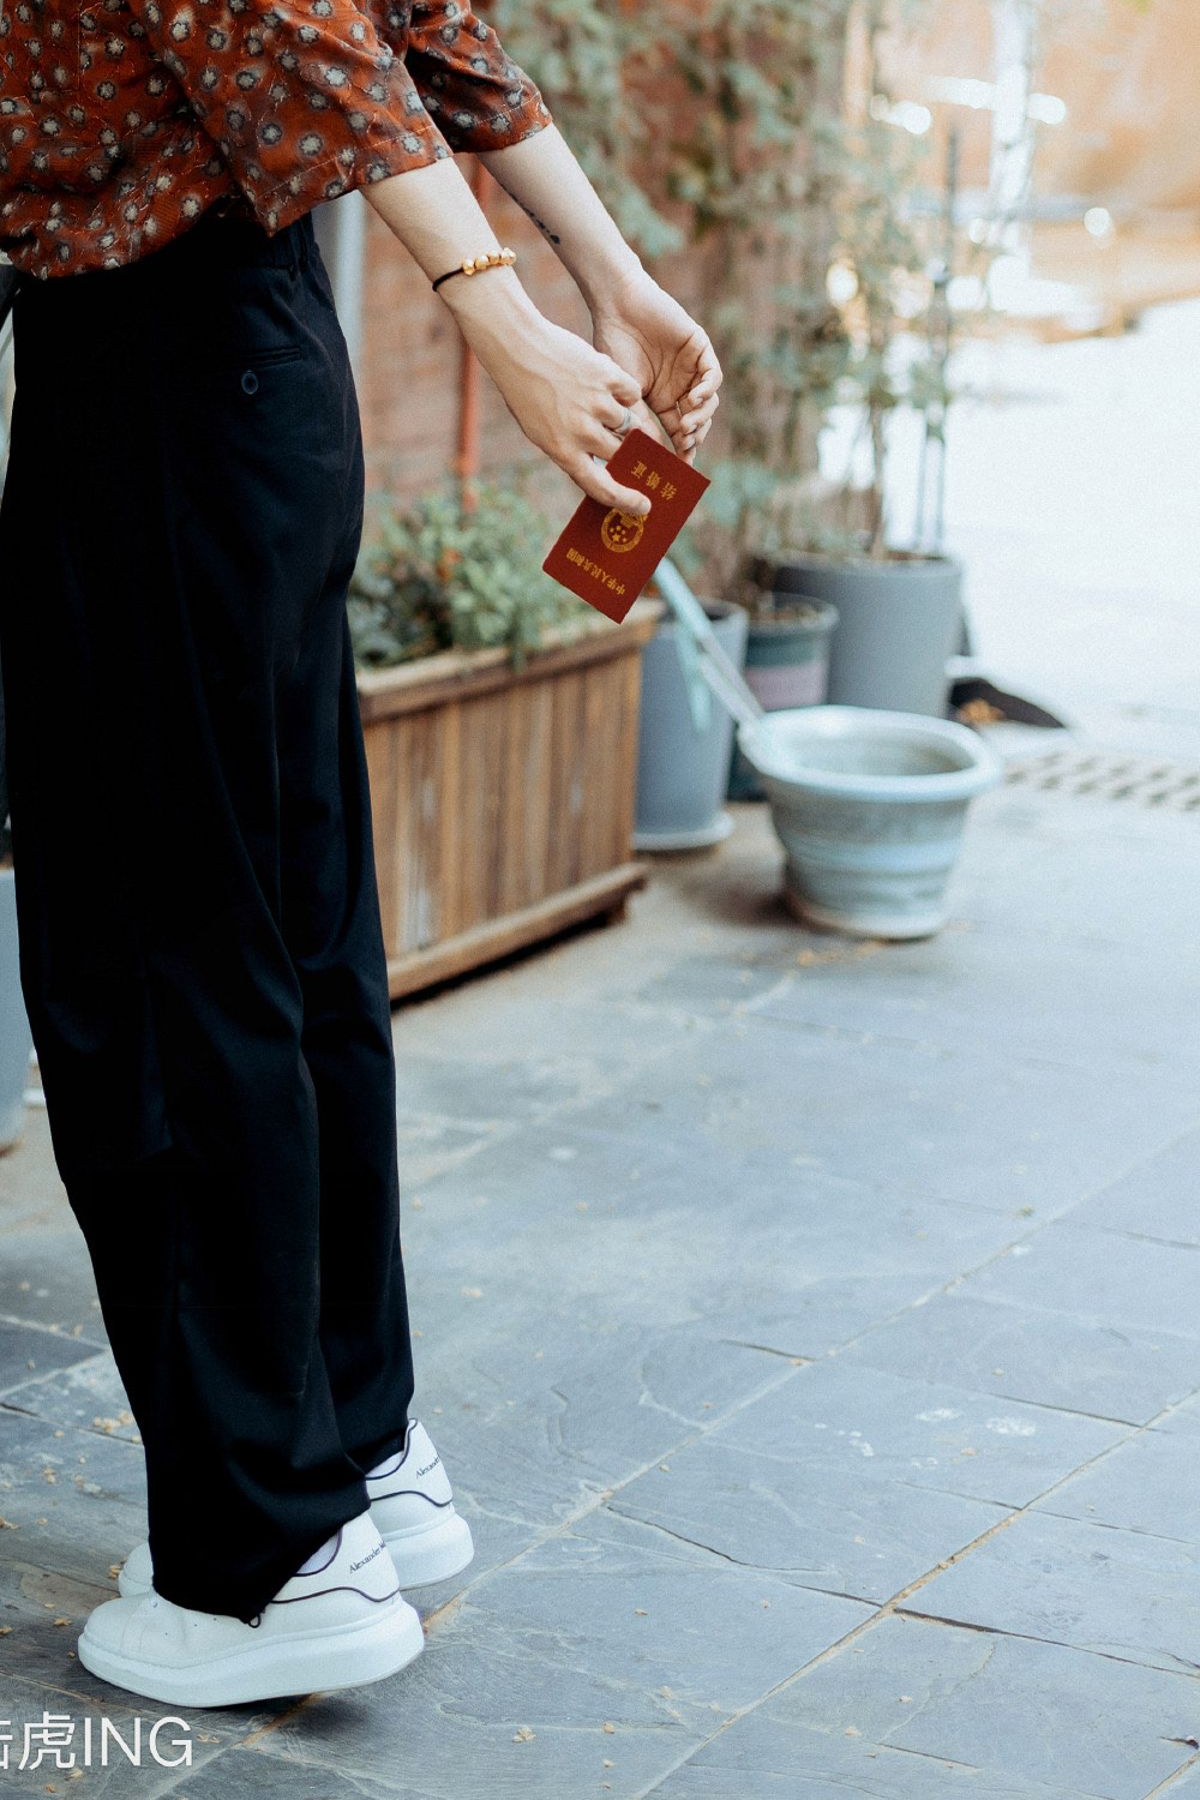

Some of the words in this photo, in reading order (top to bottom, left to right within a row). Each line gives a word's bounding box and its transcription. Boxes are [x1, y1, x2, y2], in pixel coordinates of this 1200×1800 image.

[630, 459, 678, 502] 结婚证
[565, 547, 627, 596] 中华人民共和国
